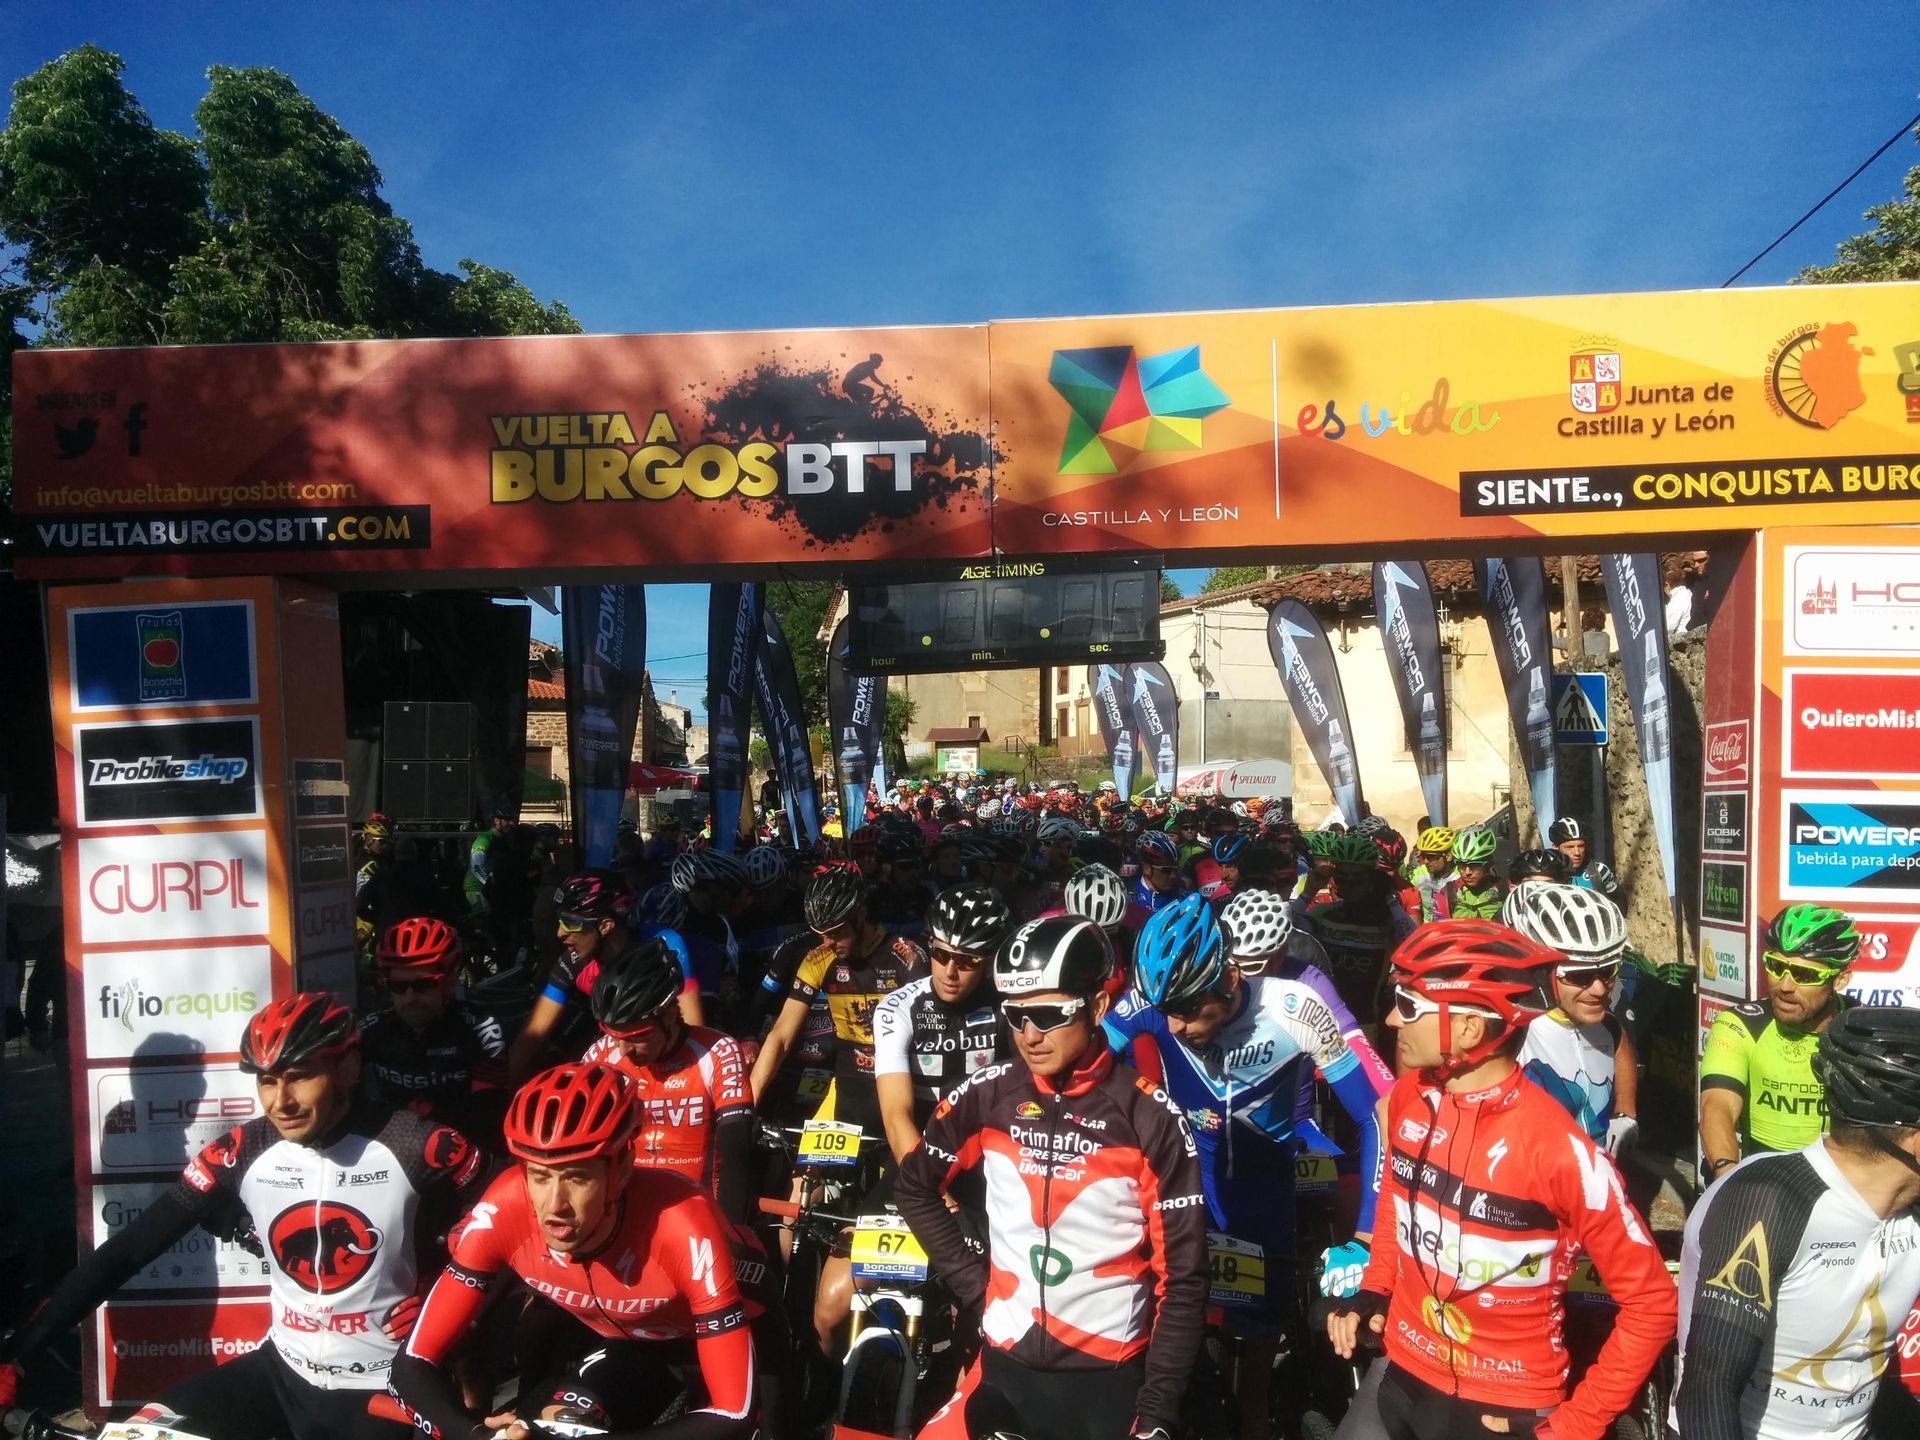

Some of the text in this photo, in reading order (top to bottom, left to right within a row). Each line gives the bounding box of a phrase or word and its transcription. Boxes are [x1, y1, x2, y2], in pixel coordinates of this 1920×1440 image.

[1768, 347, 1780, 363] de
[1776, 321, 1820, 347] burgos
[1625, 381, 1735, 406] Junta de
[1297, 376, 1501, 440] es vida
[492, 411, 679, 446] VUELTA A
[1557, 408, 1735, 438] Castilla y León
[37, 480, 357, 509] info@vueltaburgosbtt.com
[1633, 466, 1834, 503] CONQUISTA
[1042, 502, 1239, 527] CASTILLA Y LEÓN
[36, 514, 412, 549] VUELTABURGOSBTT.COM
[960, 563, 1046, 580] ALGE-TIMING
[1852, 582, 1920, 602] HC
[596, 583, 618, 664] POW
[871, 643, 1112, 667] hour min. sec.
[1801, 707, 1920, 729] QuieroMis
[91, 755, 248, 784] Probikeshop
[1238, 775, 1277, 785] SPECIALIZED
[1707, 828, 1741, 837] GOBIK
[1796, 851, 1847, 866] bebida
[1851, 854, 1885, 870] para
[89, 858, 259, 914] GURPIL
[1425, 981, 1472, 991] SPECIALIZED
[148, 1097, 256, 1120] HCB
[644, 1096, 705, 1128] EVE
[1063, 1112, 1107, 1131] POLAR
[813, 1133, 847, 1151] 109
[1010, 1125, 1103, 1156] Primaflor
[634, 1156, 654, 1165] ment
[1018, 1147, 1087, 1165] ORBEA
[350, 1169, 390, 1184] RESVER
[877, 1233, 907, 1257] 67
[1810, 1241, 1857, 1250] ORBEA
[1821, 1257, 1856, 1268] ayondo
